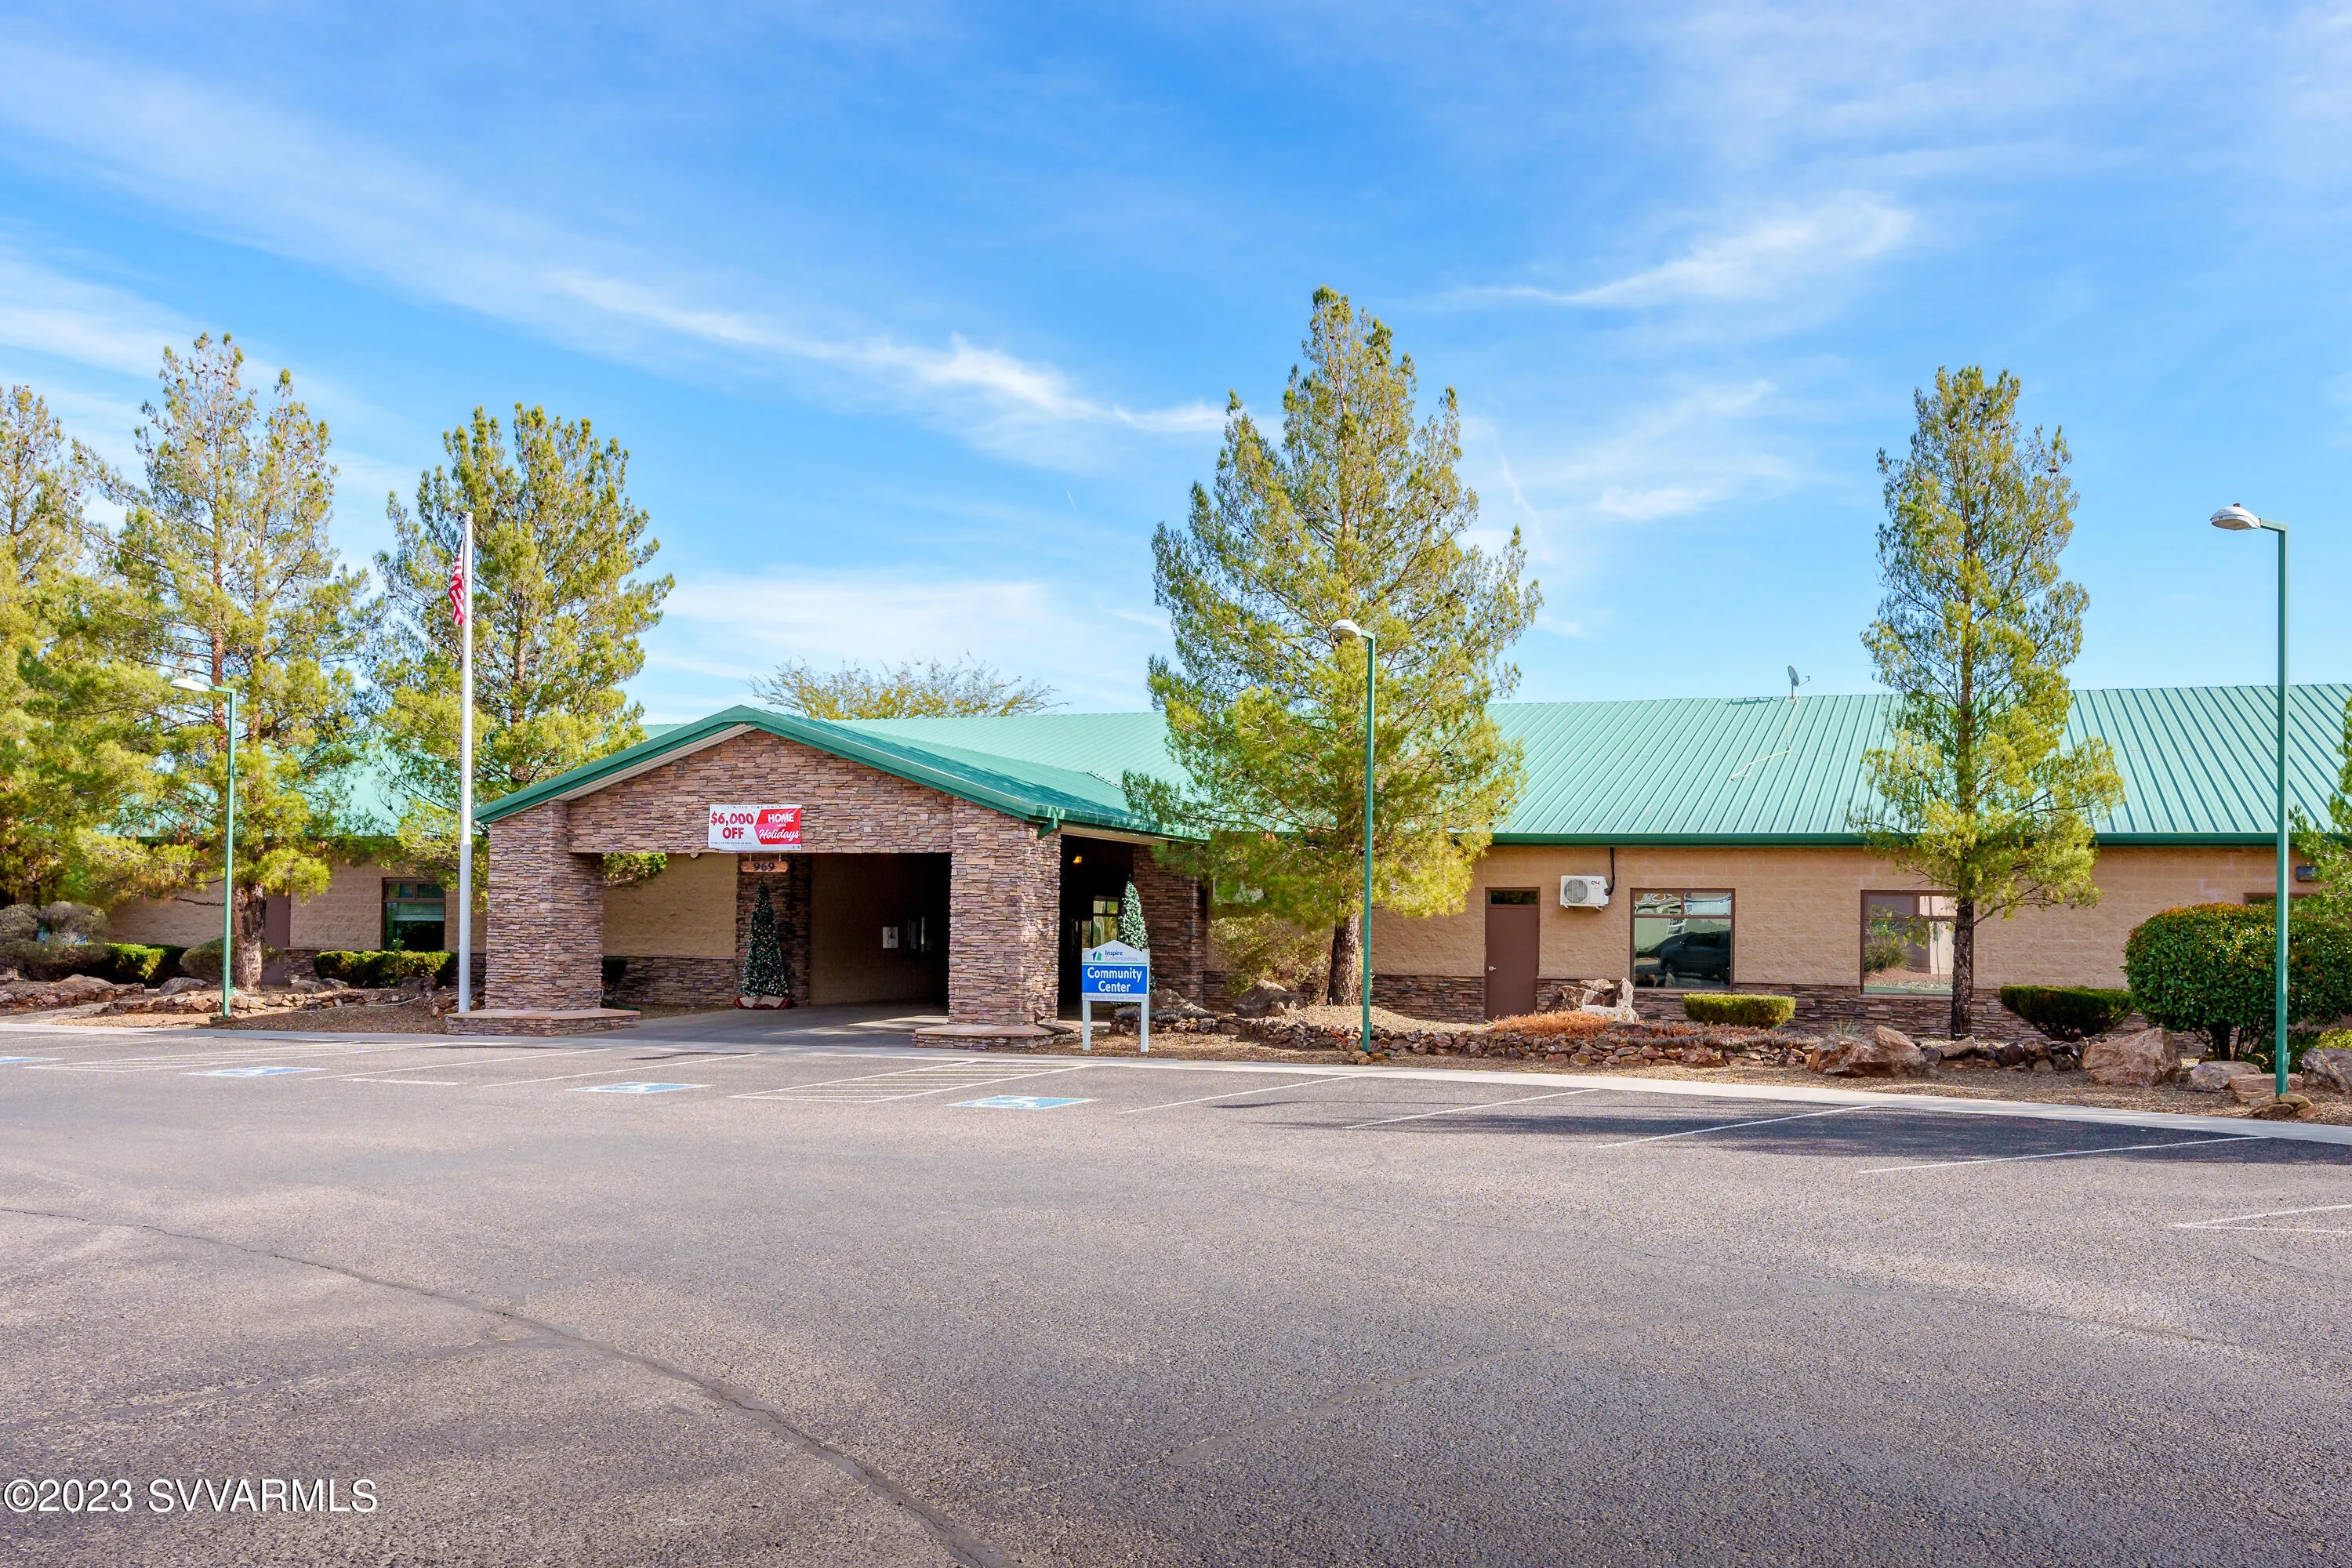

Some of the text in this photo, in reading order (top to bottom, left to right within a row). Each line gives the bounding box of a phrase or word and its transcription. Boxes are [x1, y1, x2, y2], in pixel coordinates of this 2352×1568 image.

[768, 812, 795, 823] HOME
[722, 827, 745, 840] OFF
[758, 829, 800, 842] Holidays
[753, 862, 775, 872] 969
[1087, 967, 1142, 983] Community
[1098, 981, 1131, 993] Center
